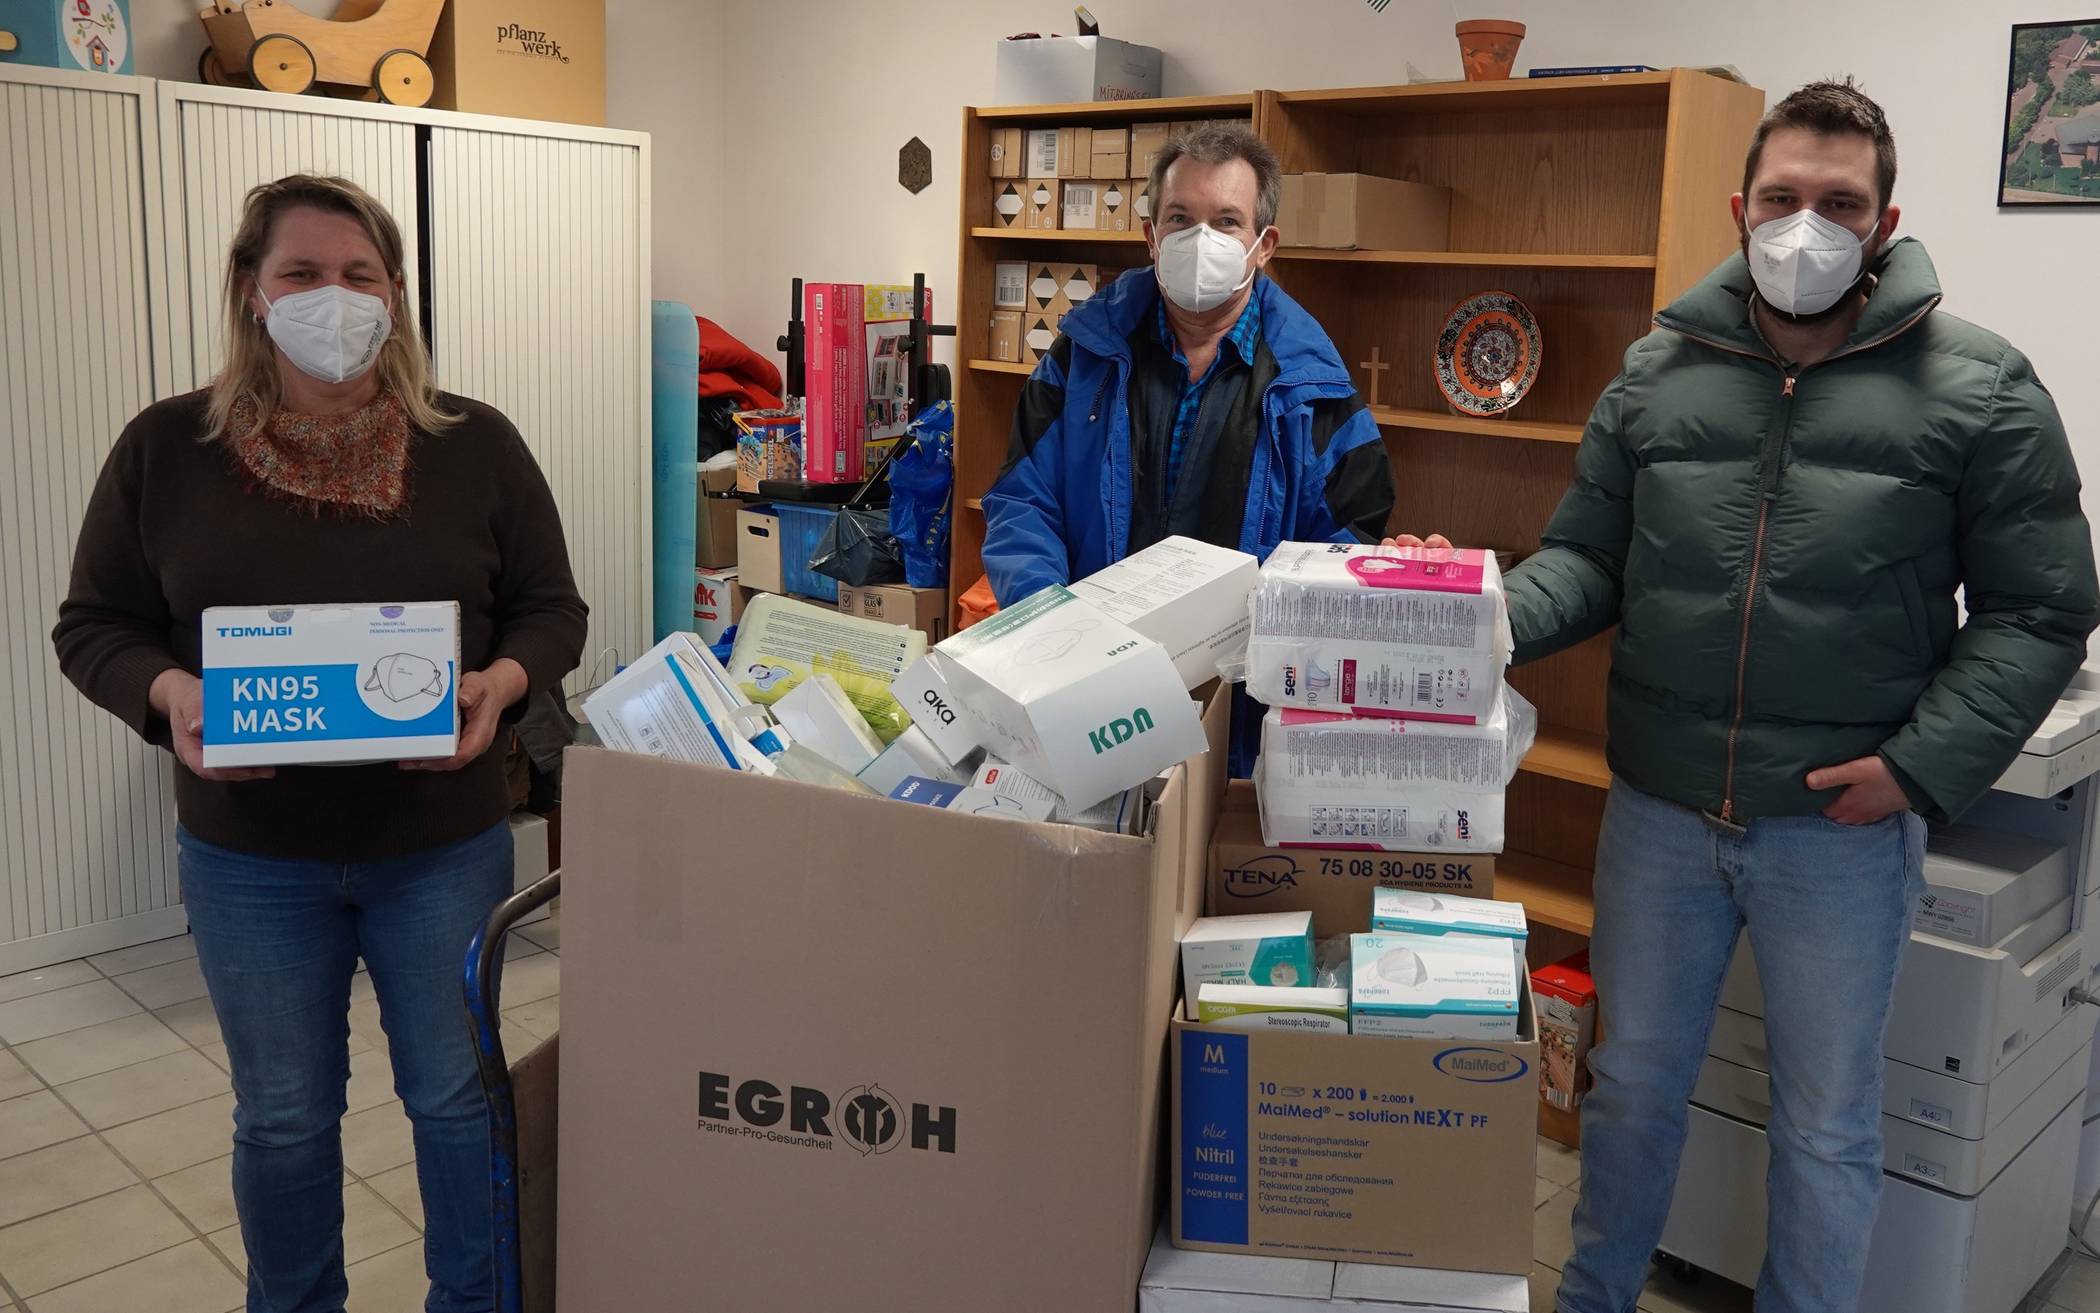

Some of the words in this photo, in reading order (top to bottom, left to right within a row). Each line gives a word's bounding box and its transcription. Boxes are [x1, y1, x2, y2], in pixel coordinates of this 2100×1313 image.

[496, 23, 547, 44] pflanz
[522, 41, 570, 64] werk
[216, 626, 293, 638] TOMUGI
[232, 675, 320, 702] KN95
[1283, 664, 1297, 697] seni
[923, 689, 957, 726] aka
[232, 706, 328, 734] MASK
[1457, 809, 1472, 841] seni
[1223, 868, 1304, 887] TENA
[1319, 858, 1344, 876] 75
[1349, 858, 1374, 877] 08
[1379, 860, 1437, 880] 30-05
[1443, 862, 1473, 882] SK
[1395, 880, 1424, 888] HYGIENE
[1425, 881, 1462, 890] PRODUCTS
[1366, 937, 1384, 949] 20
[1267, 1015, 1302, 1028] Stereoscopic
[1302, 1018, 1331, 1029] Respirator
[1203, 1044, 1225, 1064] M
[1200, 1066, 1229, 1074] medium
[1258, 1082, 1277, 1096] 10
[1312, 1088, 1322, 1099] x
[1326, 1086, 1355, 1100] 200
[1381, 1094, 1407, 1104] 2.000
[698, 1071, 957, 1156] EGROH
[1348, 1109, 1409, 1125] solution
[1413, 1109, 1465, 1127] NEXT
[1470, 1114, 1489, 1128] PF
[1919, 1108, 1934, 1120] A4
[697, 1119, 833, 1151] Partner-Pro-Gesundheit
[1202, 1122, 1228, 1140] blue
[1195, 1146, 1235, 1165] Nitril
[1193, 1171, 1237, 1184] PUDERFREI
[1258, 1168, 1303, 1181] Перчатки
[1305, 1172, 1323, 1182] для
[1913, 1163, 1928, 1175] A3
[1186, 1187, 1222, 1199] POWDER
[1225, 1191, 1245, 1201] FREE
[1258, 1180, 1302, 1193] Rękawice
[1304, 1183, 1355, 1197] zabiegowe
[1313, 1207, 1353, 1220] rukavice
